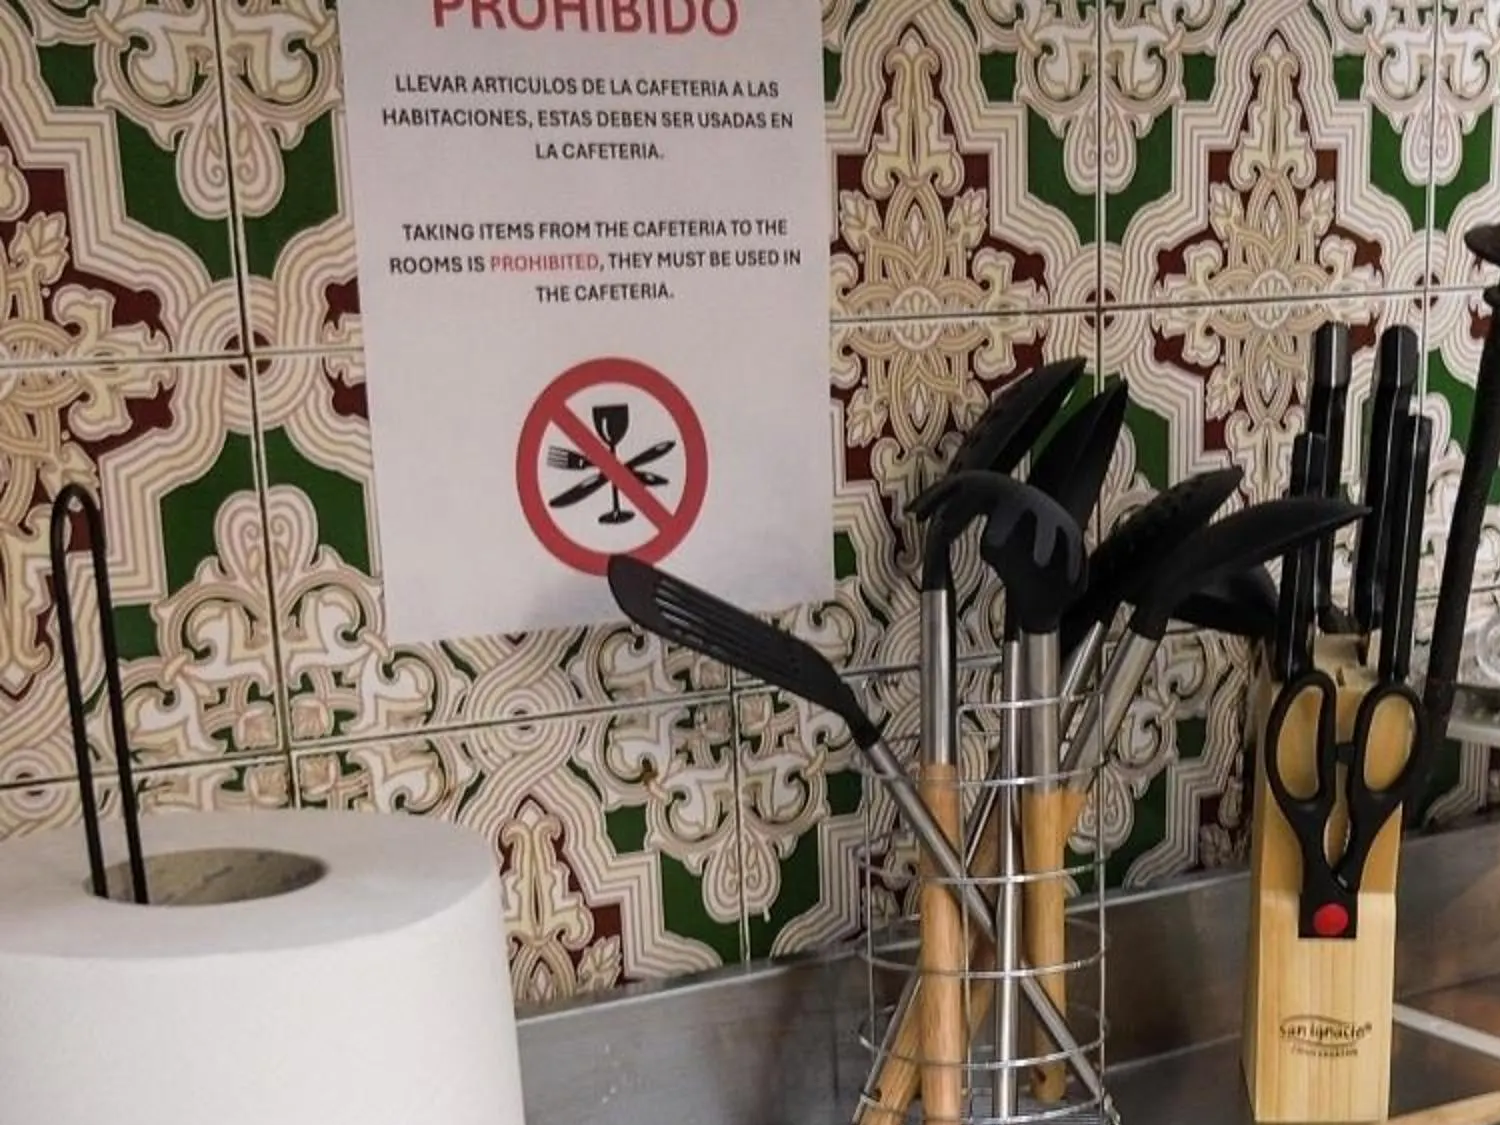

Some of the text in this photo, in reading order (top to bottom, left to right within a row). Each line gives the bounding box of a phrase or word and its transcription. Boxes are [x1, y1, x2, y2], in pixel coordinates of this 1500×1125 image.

[433, 0, 739, 36] PROHIBIDO
[395, 74, 779, 99] LLEVAR ARTICULOS DE LA CAFETERIA A LAS
[382, 108, 793, 129] HABITACIONES, ESTAS DEBEN SER USADAS EN
[535, 142, 664, 160] LA CAFETERIA.
[402, 218, 787, 242] TAKING ITEMS FROM THE CAFETERIA TO THE
[389, 248, 801, 275] ROOMS IS PROHIBITED, THEY MUST BE USED IN
[535, 282, 674, 304] THE CAFETERIA.
